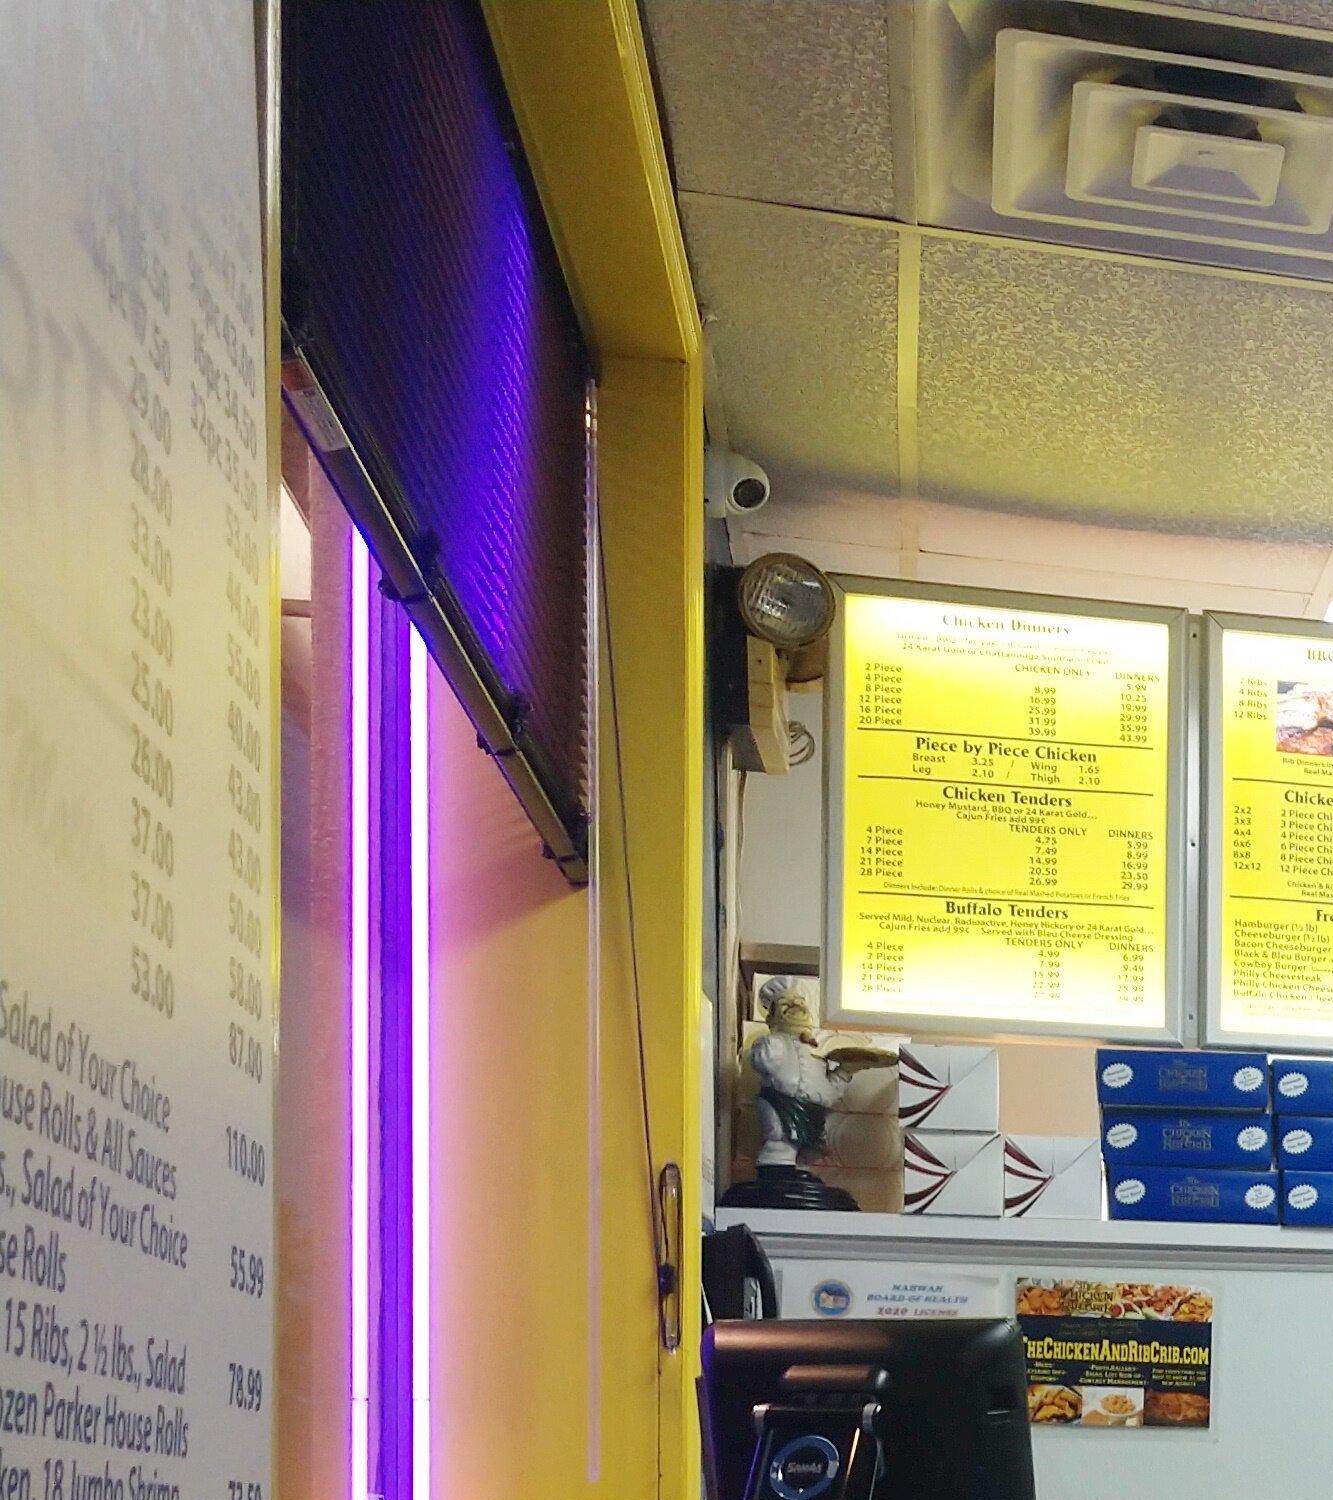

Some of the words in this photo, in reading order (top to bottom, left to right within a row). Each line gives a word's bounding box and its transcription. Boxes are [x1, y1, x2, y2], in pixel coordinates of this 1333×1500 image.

[912, 752, 946, 765] Breast
[971, 757, 994, 768] 3.25
[1030, 762, 1058, 774] Wing
[912, 765, 932, 777] Leg
[971, 768, 994, 779] 2.10
[1030, 773, 1060, 785] Thigh
[1078, 776, 1101, 786] 2.10
[915, 737, 957, 754] Piece
[963, 741, 983, 757] by
[987, 742, 1030, 758] Piece
[1035, 745, 1097, 763] Chicken
[942, 785, 1006, 804] Chicken
[1011, 790, 1072, 807] Tenders
[945, 901, 1003, 917] Buffalo
[1008, 904, 1069, 920] Tenders
[55, 1022, 76, 1077] of
[78, 1027, 118, 1100] Your
[120, 1058, 171, 1134] Choice
[39, 1080, 82, 1155] Rolls
[86, 1107, 98, 1161] &
[101, 1117, 124, 1175] All
[126, 1128, 177, 1201] Sauces
[226, 1126, 266, 1187] 110.00
[22, 1148, 76, 1224] Salad
[77, 1175, 98, 1231] of
[100, 1181, 137, 1248] Your
[140, 1202, 188, 1270] Choice
[23, 1223, 68, 1294] Rolls
[230, 1245, 264, 1299] 55.99
[5, 1296, 27, 1358] 15
[31, 1303, 74, 1377] Ribs,
[77, 1318, 89, 1372] 2
[145, 1336, 188, 1395] Salad
[228, 1363, 262, 1412] 78.99
[43, 1381, 101, 1444] Parker
[104, 1393, 152, 1454] House
[155, 1404, 189, 1459] Rolls
